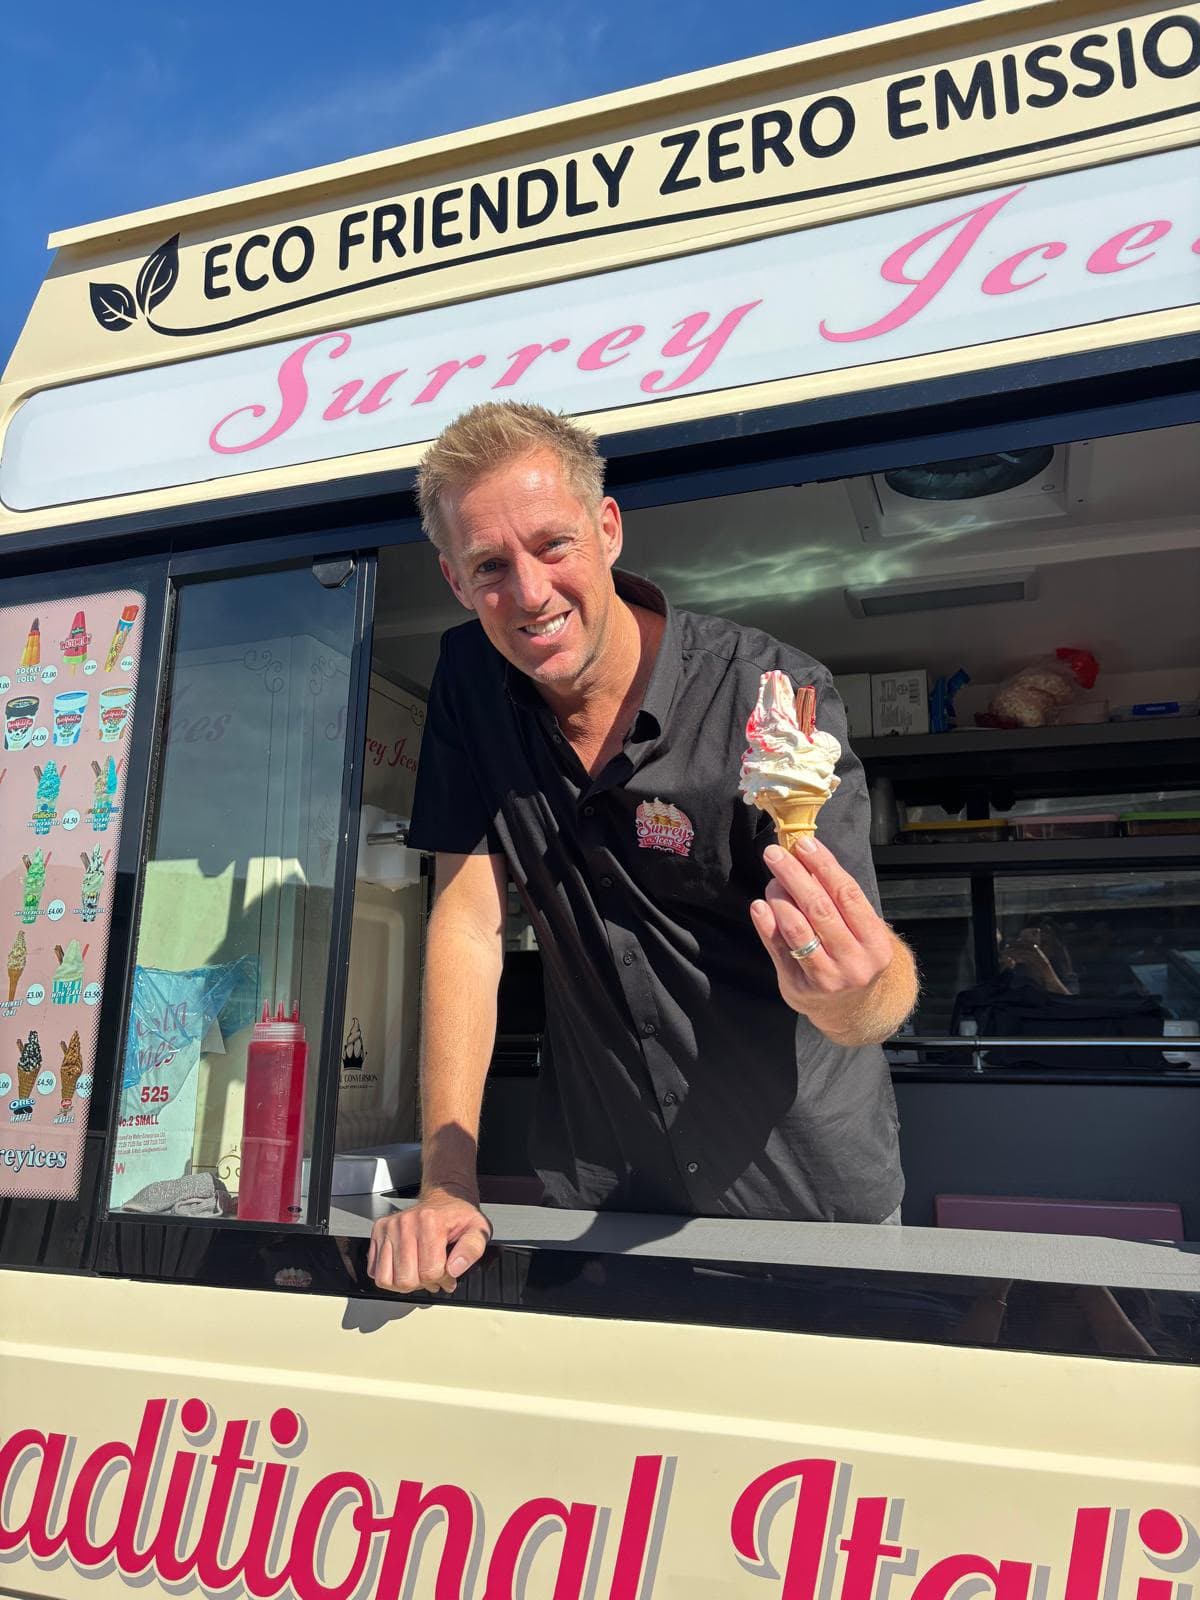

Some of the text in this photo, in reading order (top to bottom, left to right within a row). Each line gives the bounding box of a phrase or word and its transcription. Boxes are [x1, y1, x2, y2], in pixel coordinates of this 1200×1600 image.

[203, 14, 1200, 300] ECO FRIENDLY ZERO EMISSIO
[208, 185, 1200, 455] Surrey Ice
[32, 732, 47, 741] £4.00
[62, 817, 78, 825] £4.50
[638, 819, 689, 843] Surrey
[141, 1086, 169, 1102] 525
[10, 1099, 35, 1109] OREO
[135, 1114, 159, 1126] SMALL
